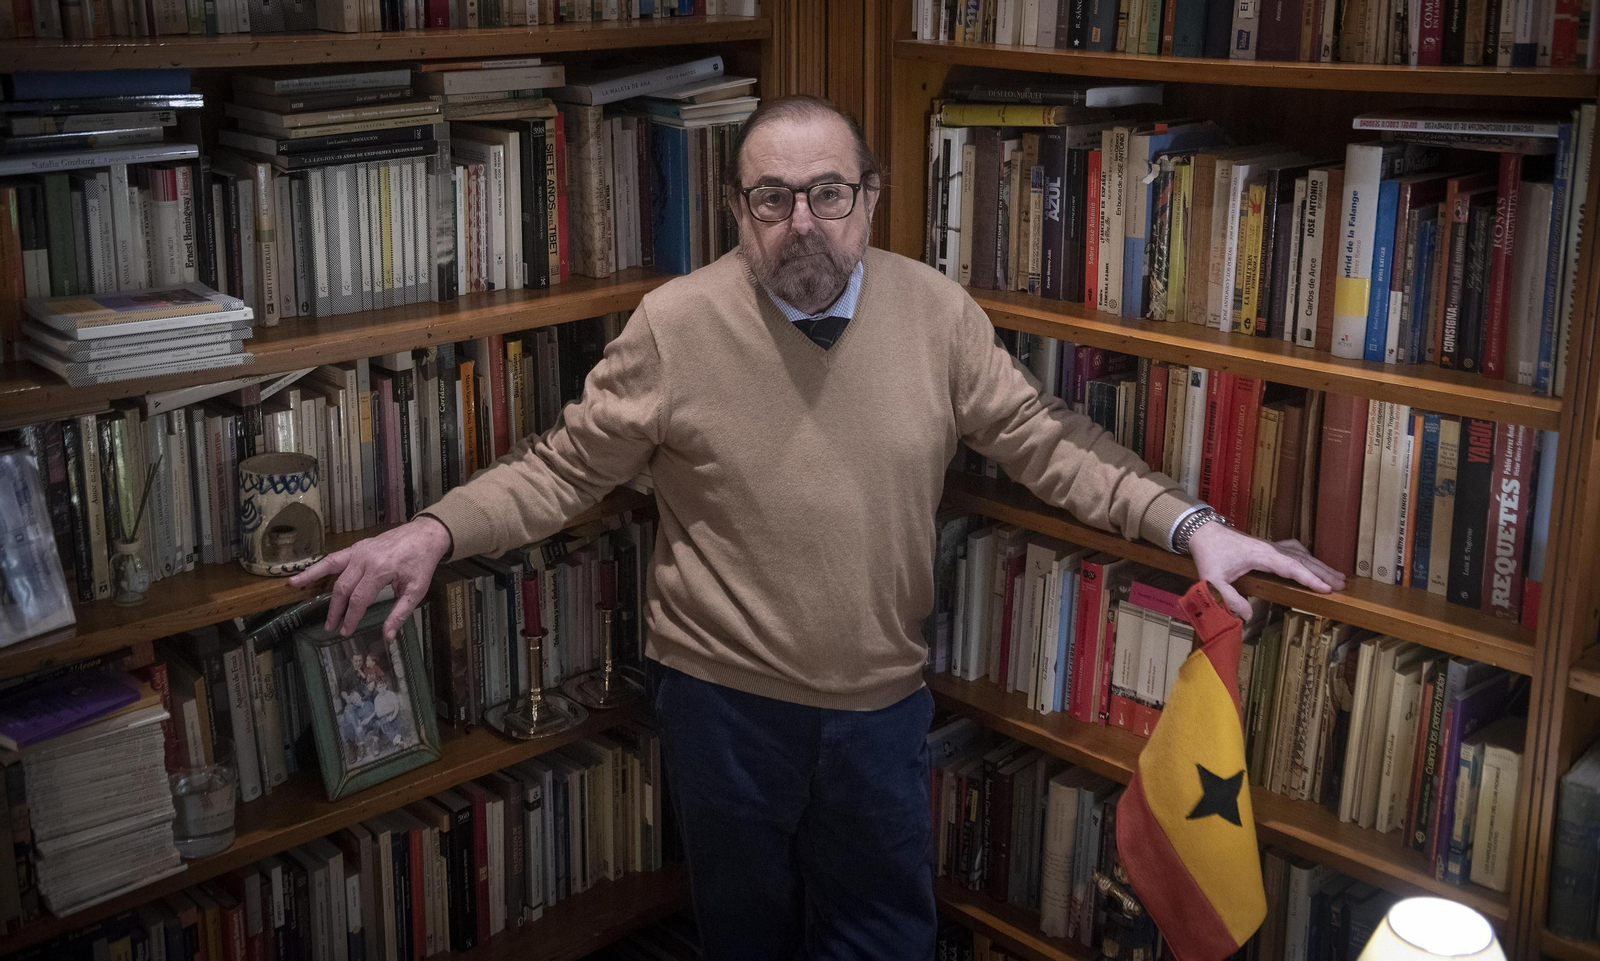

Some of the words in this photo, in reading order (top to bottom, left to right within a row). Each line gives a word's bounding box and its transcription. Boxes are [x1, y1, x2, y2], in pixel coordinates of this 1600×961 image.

[680, 70, 697, 78] SANTOS
[609, 85, 631, 94] MALETA
[32, 160, 59, 170] Natalia
[61, 157, 95, 168] Ginzburg
[364, 149, 391, 157] UNIFORMES
[392, 146, 423, 154] LEGIONARIOS
[546, 143, 554, 175] SIETE
[1394, 159, 1403, 174] El
[180, 171, 189, 196] Fiesta
[548, 179, 556, 210] AÑOS
[1049, 177, 1061, 222] AZUL
[1308, 179, 1318, 217] ANTONIO
[1348, 190, 1360, 227] Falange
[1554, 185, 1565, 220] PERDIDA
[182, 196, 193, 241] Hemingway
[1116, 206, 1122, 216] En
[1493, 197, 1507, 248] ROSAS
[1505, 189, 1517, 256] MARGARITAS
[550, 225, 558, 255] TIBET
[1347, 230, 1355, 238] la
[185, 242, 194, 268] Ernest
[1346, 241, 1354, 253] de
[1354, 239, 1362, 259] Riesco
[1454, 237, 1464, 264] ANTONIO
[264, 244, 272, 281] FITZGERALD
[1244, 254, 1253, 295] REVOLUCIÓN
[1308, 257, 1317, 277] Arce
[1345, 255, 1353, 278] adrid
[1352, 259, 1360, 275] Jerez
[1452, 264, 1461, 279] JOSÉ
[106, 271, 114, 290] Donde
[1307, 278, 1315, 289] de
[1548, 274, 1556, 286] LA
[1244, 296, 1250, 306] LA
[1305, 290, 1315, 316] Carlos
[1450, 284, 1459, 305] MATAR
[1547, 288, 1555, 303] POR
[1443, 304, 1458, 353] CONSIGNA:
[1140, 358, 1149, 385] Ridruejo
[438, 379, 446, 413] Cortázar
[1139, 385, 1147, 411] Dionisio
[1206, 401, 1217, 442] desconocido
[1236, 404, 1246, 437] PUEBLO
[1368, 416, 1376, 435] García
[1137, 419, 1145, 448] rescatada
[1235, 438, 1243, 450] UN
[1366, 435, 1375, 455] Rafael
[1374, 438, 1381, 447] La
[1385, 430, 1393, 450] Andrés
[1467, 418, 1493, 463] YAGÜE
[1504, 439, 1515, 458] Larraz
[1233, 452, 1242, 473] PARA
[1503, 459, 1512, 475] Pablo
[91, 484, 99, 505] Amor
[1230, 474, 1240, 517] PENSADOR
[1400, 492, 1408, 519] SILENCIO
[1464, 527, 1474, 553] Togores
[1491, 477, 1521, 609] REQUETÉS
[514, 571, 522, 595] Umbral
[515, 595, 523, 625] Francisco
[68, 658, 102, 674] Aldecoa
[230, 655, 239, 673] Foxá
[233, 673, 241, 682] de
[1434, 672, 1445, 700] hablan
[234, 682, 244, 709] Agustín
[1431, 702, 1442, 730] perros
[1428, 731, 1438, 742] los
[1425, 743, 1437, 776] Cuando
